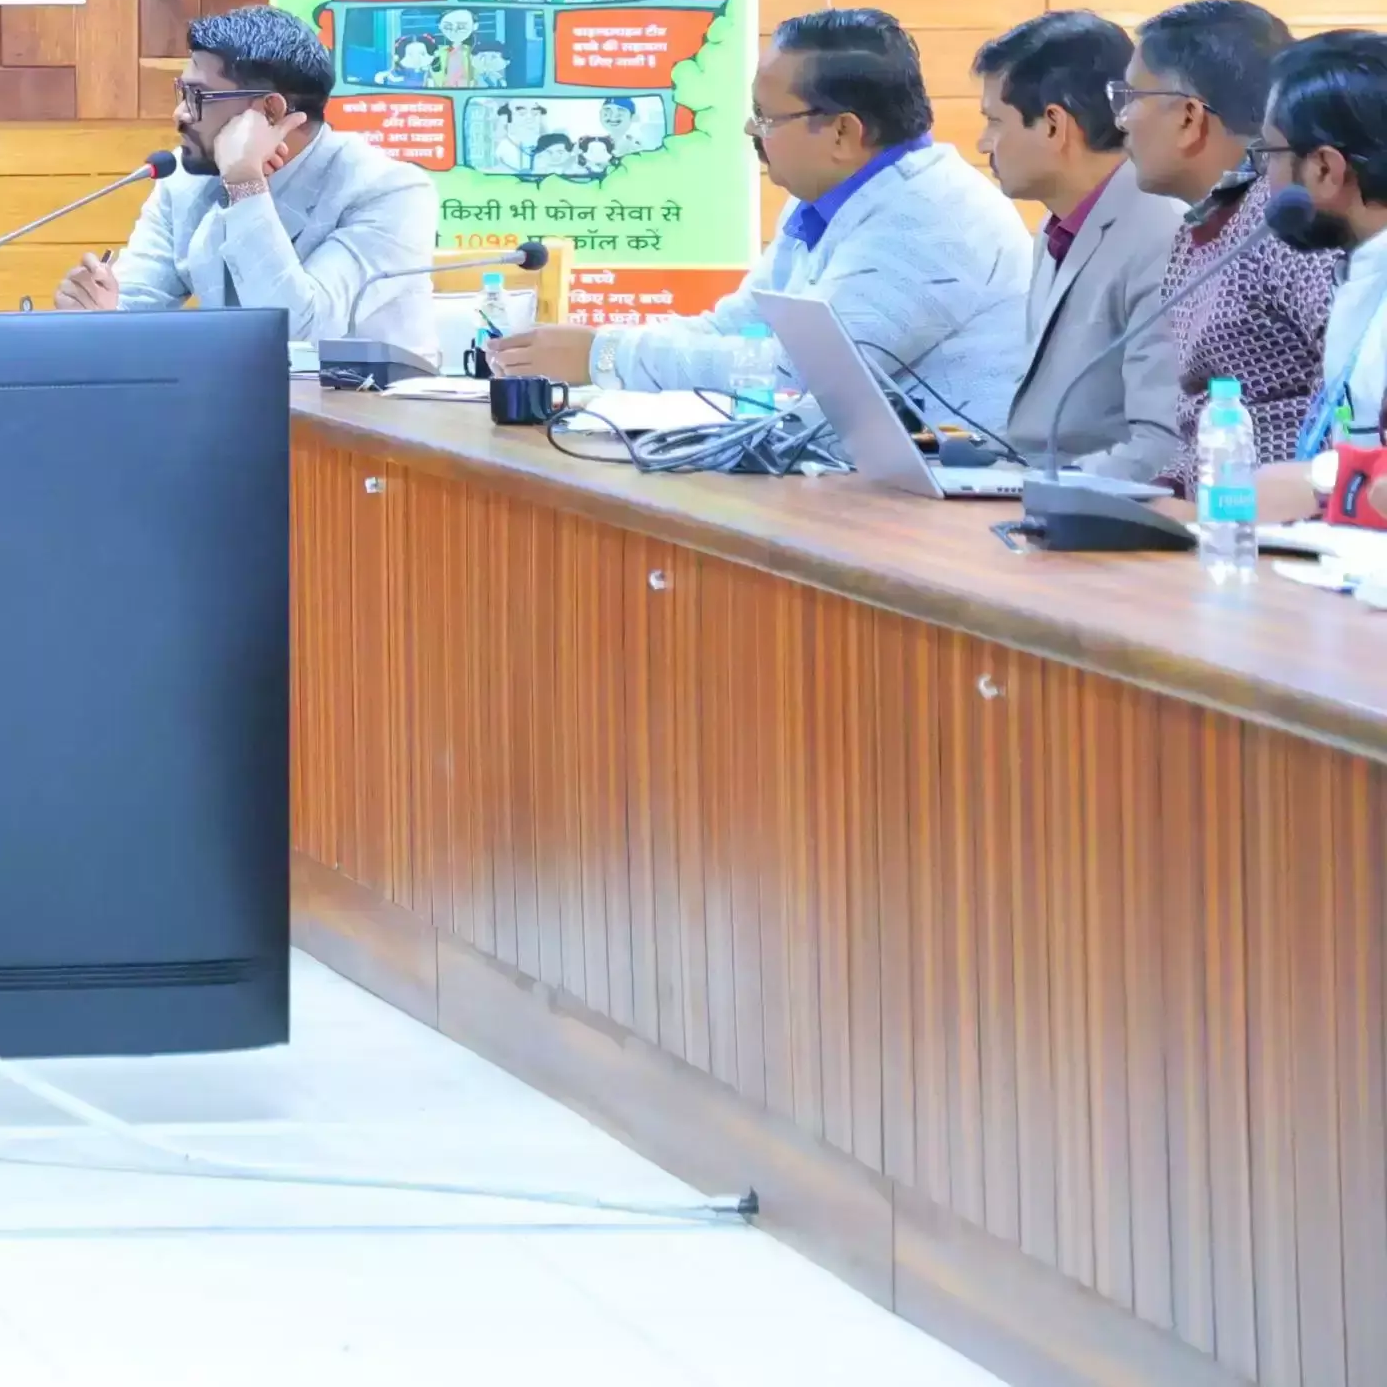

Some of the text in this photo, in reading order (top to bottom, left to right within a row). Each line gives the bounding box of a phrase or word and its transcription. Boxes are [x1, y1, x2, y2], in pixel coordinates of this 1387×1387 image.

[441, 198, 683, 223] किसी भी फोन सेवा से
[626, 228, 663, 251] करें
